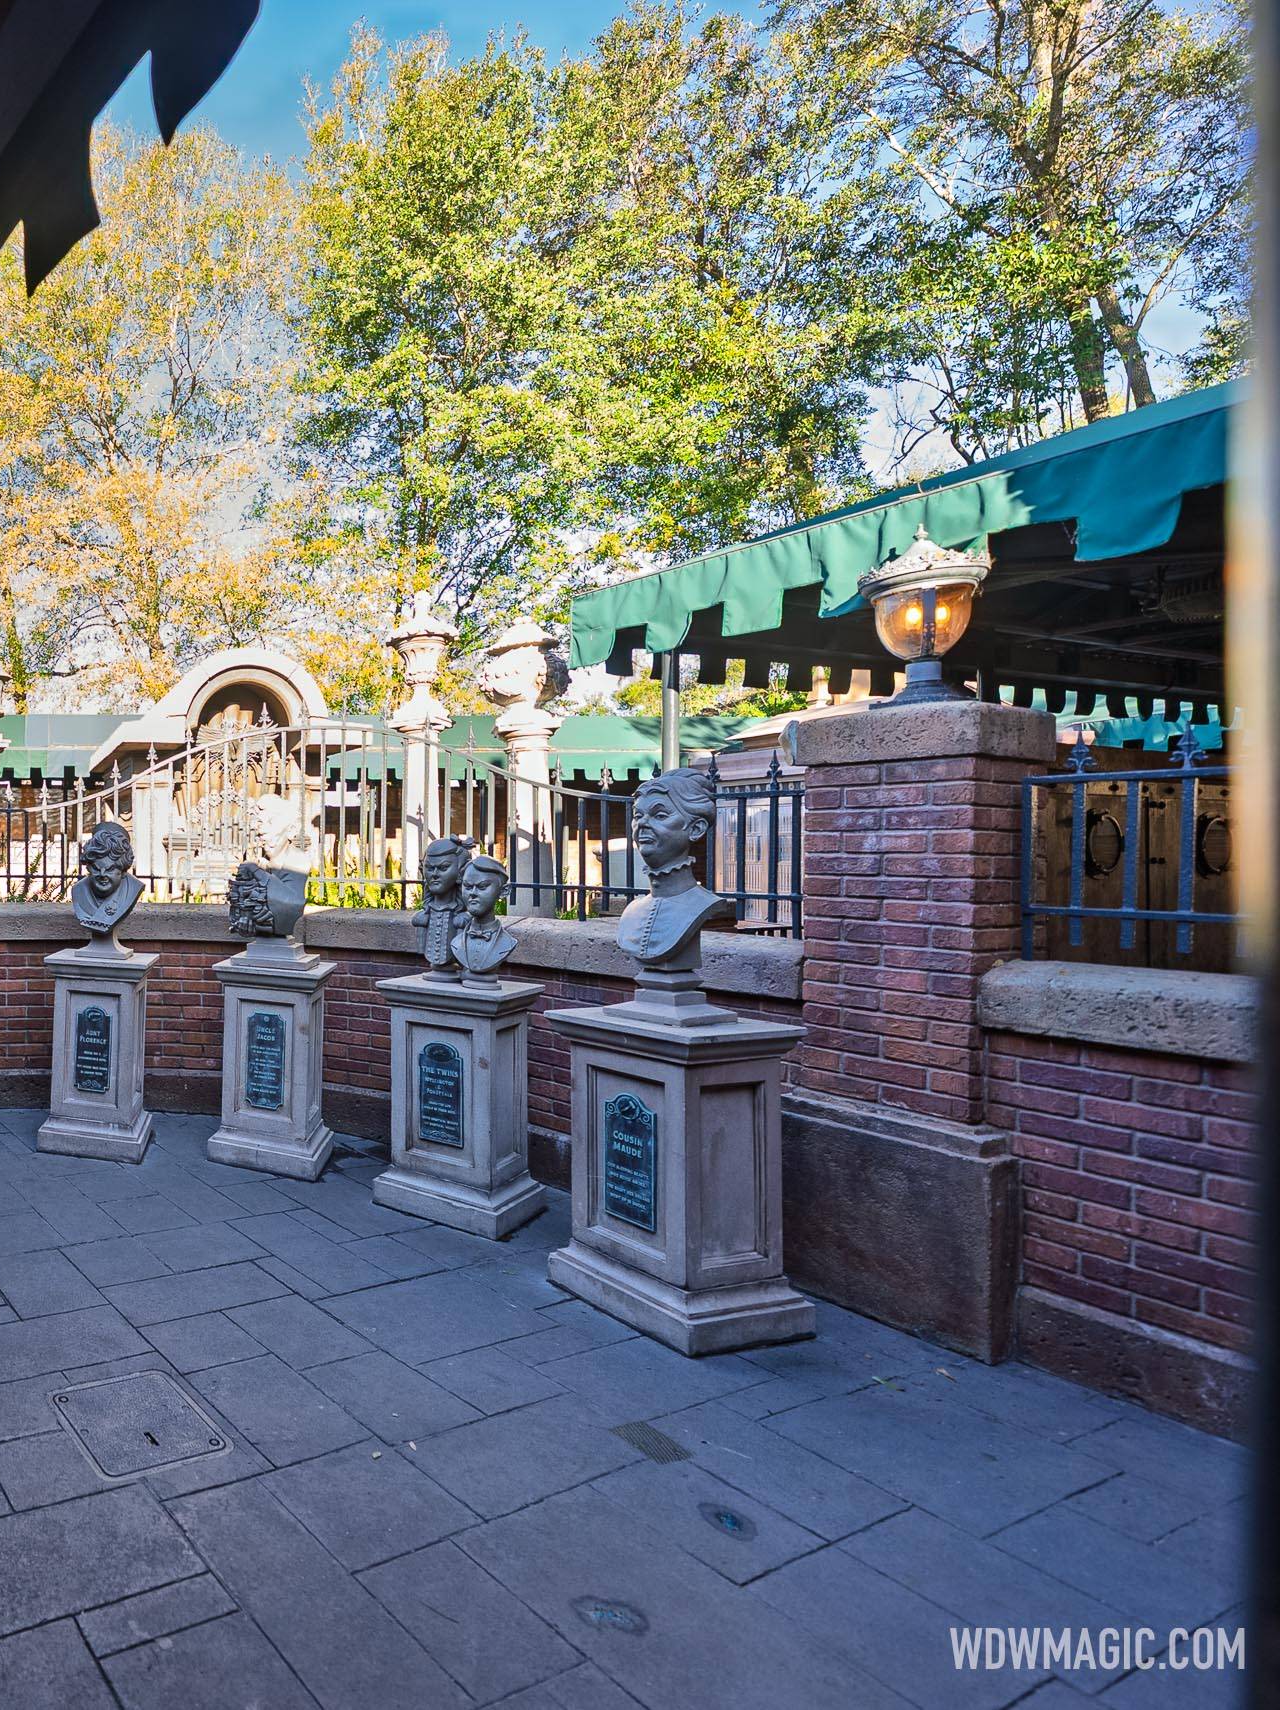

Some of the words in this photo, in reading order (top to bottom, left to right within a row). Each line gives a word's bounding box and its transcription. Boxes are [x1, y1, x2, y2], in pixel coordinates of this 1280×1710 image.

[256, 1025, 276, 1034] UNCLE
[613, 1130, 644, 1147] COUSIN
[612, 1141, 643, 1159] MAUDE
